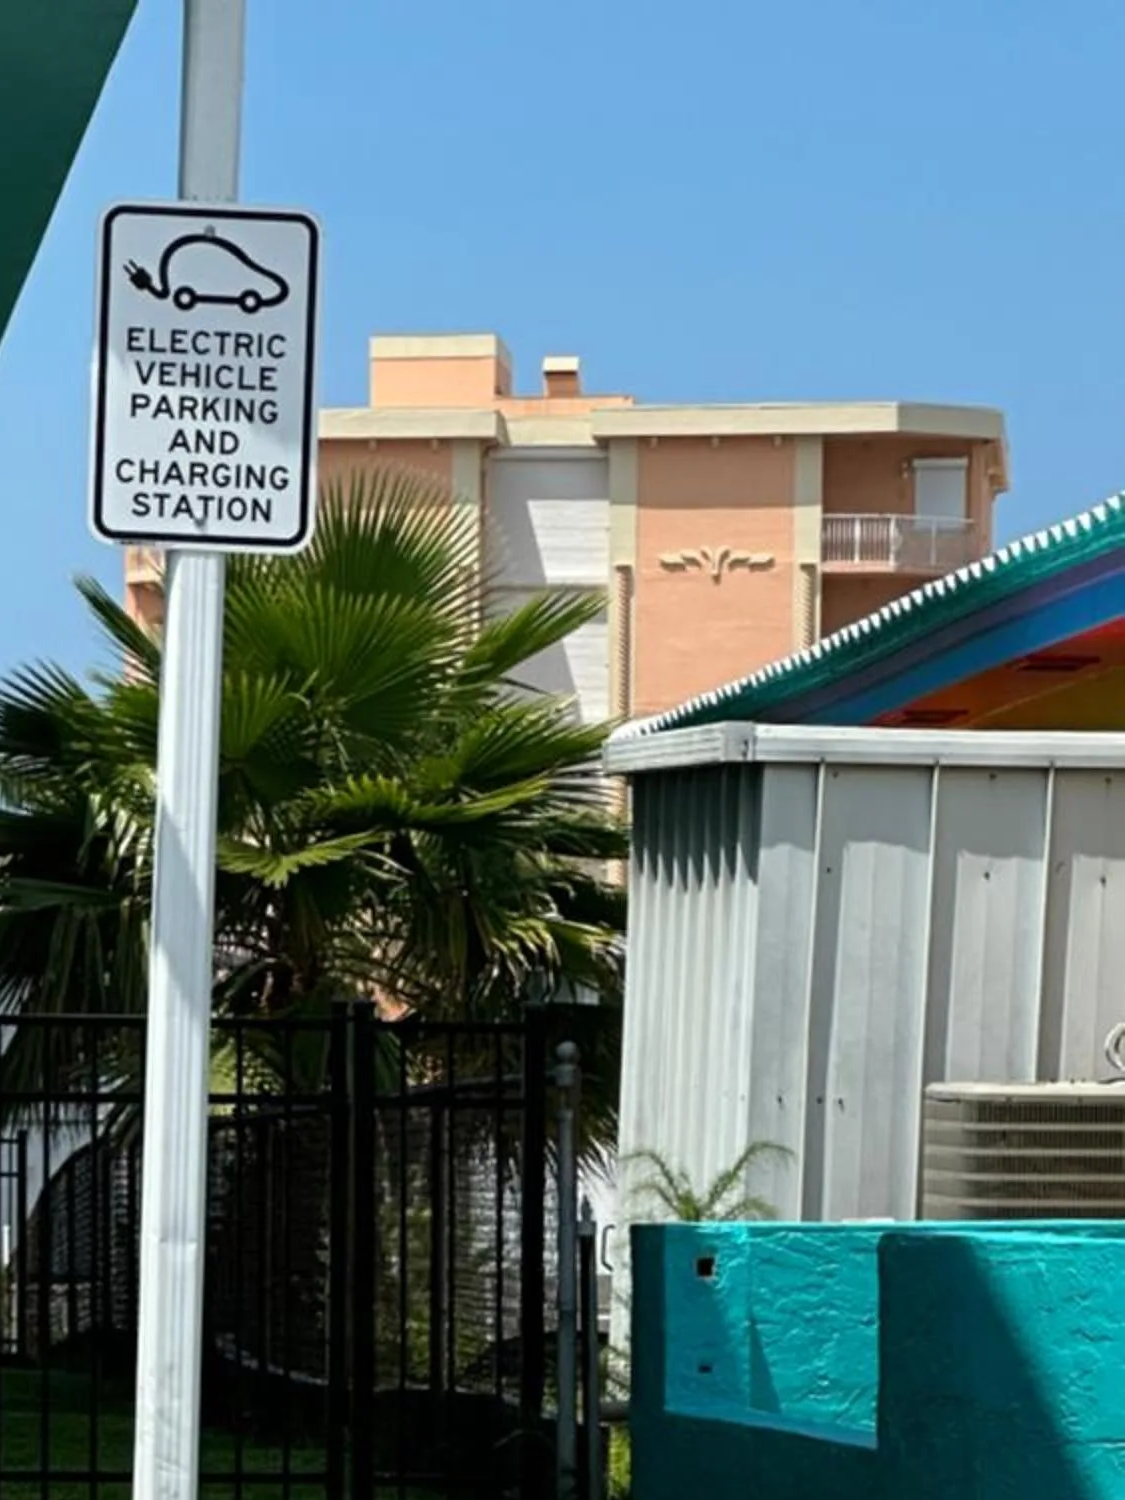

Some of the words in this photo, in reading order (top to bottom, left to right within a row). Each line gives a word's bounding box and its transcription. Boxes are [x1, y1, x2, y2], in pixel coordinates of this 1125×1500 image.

[126, 327, 287, 359] ELECTRIC
[135, 361, 278, 392] VEHICLE
[130, 394, 279, 425] PARKING
[168, 429, 240, 456] AND
[115, 459, 290, 491] CHARGING
[131, 493, 272, 523] STATION
